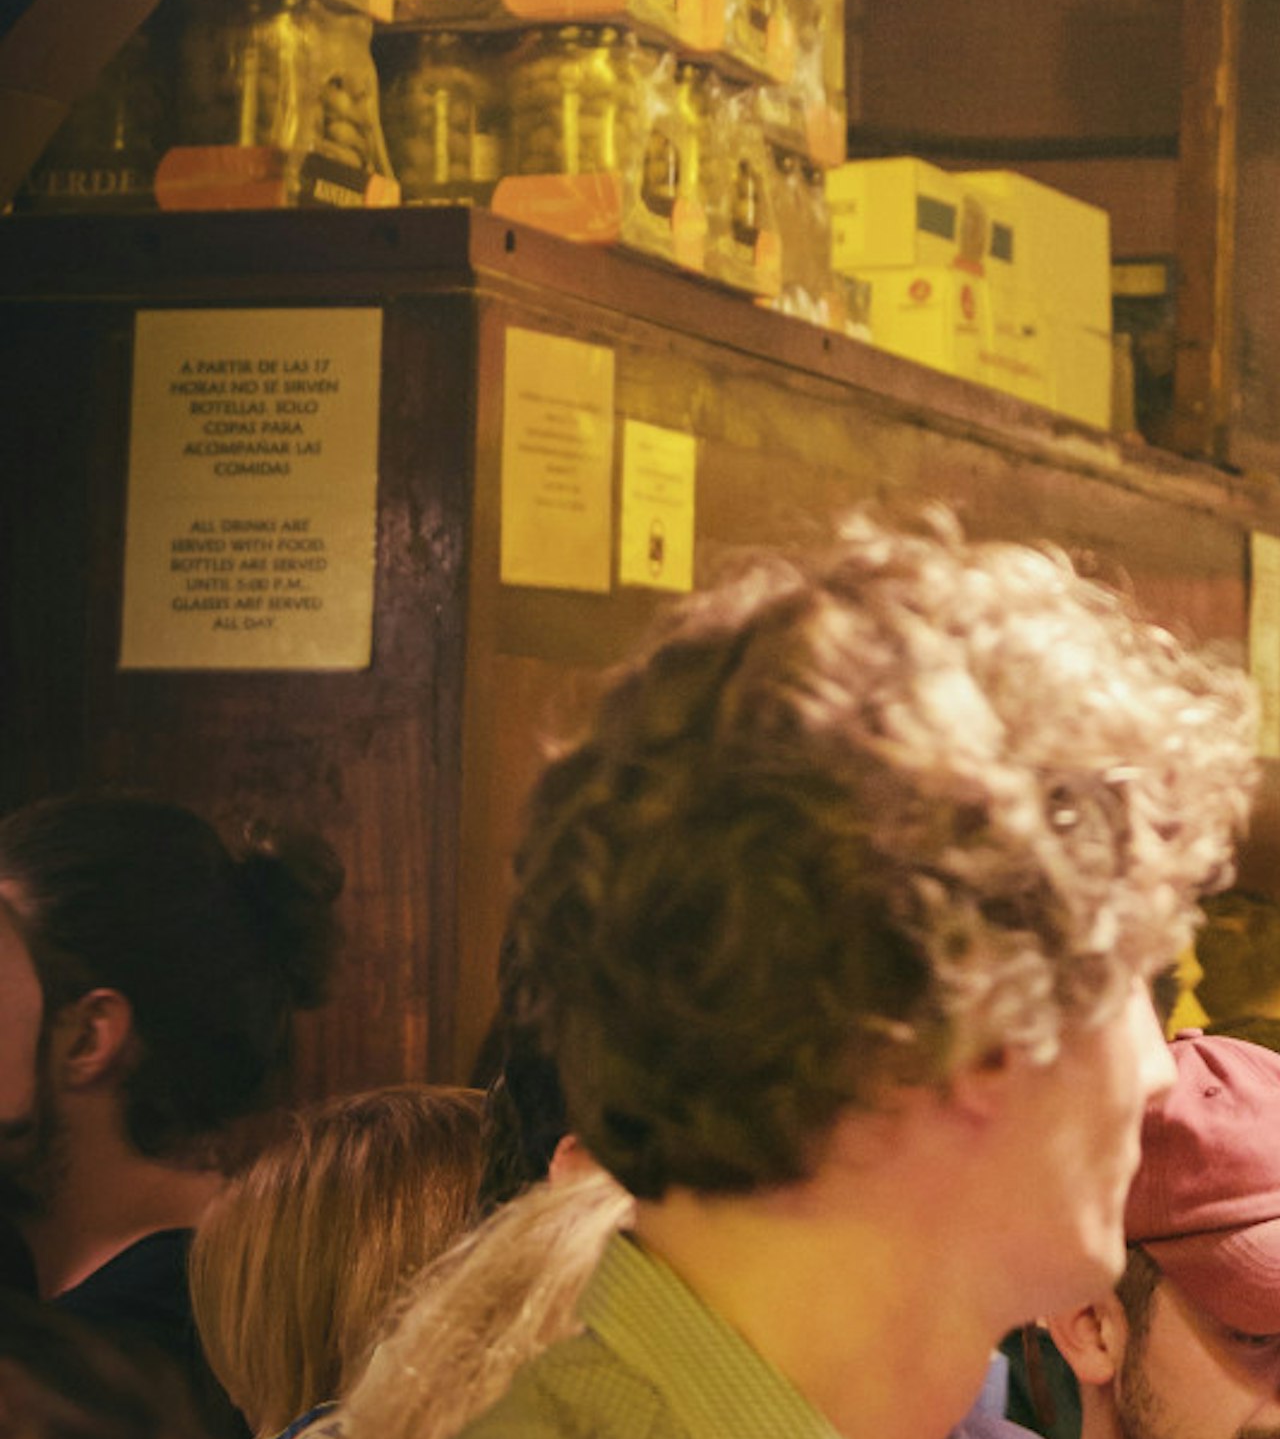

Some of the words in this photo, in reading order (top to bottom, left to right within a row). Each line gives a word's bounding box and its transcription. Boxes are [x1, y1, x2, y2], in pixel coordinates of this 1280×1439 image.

[258, 359, 278, 374] DE
[230, 379, 258, 395] NO
[262, 420, 304, 436] PARA
